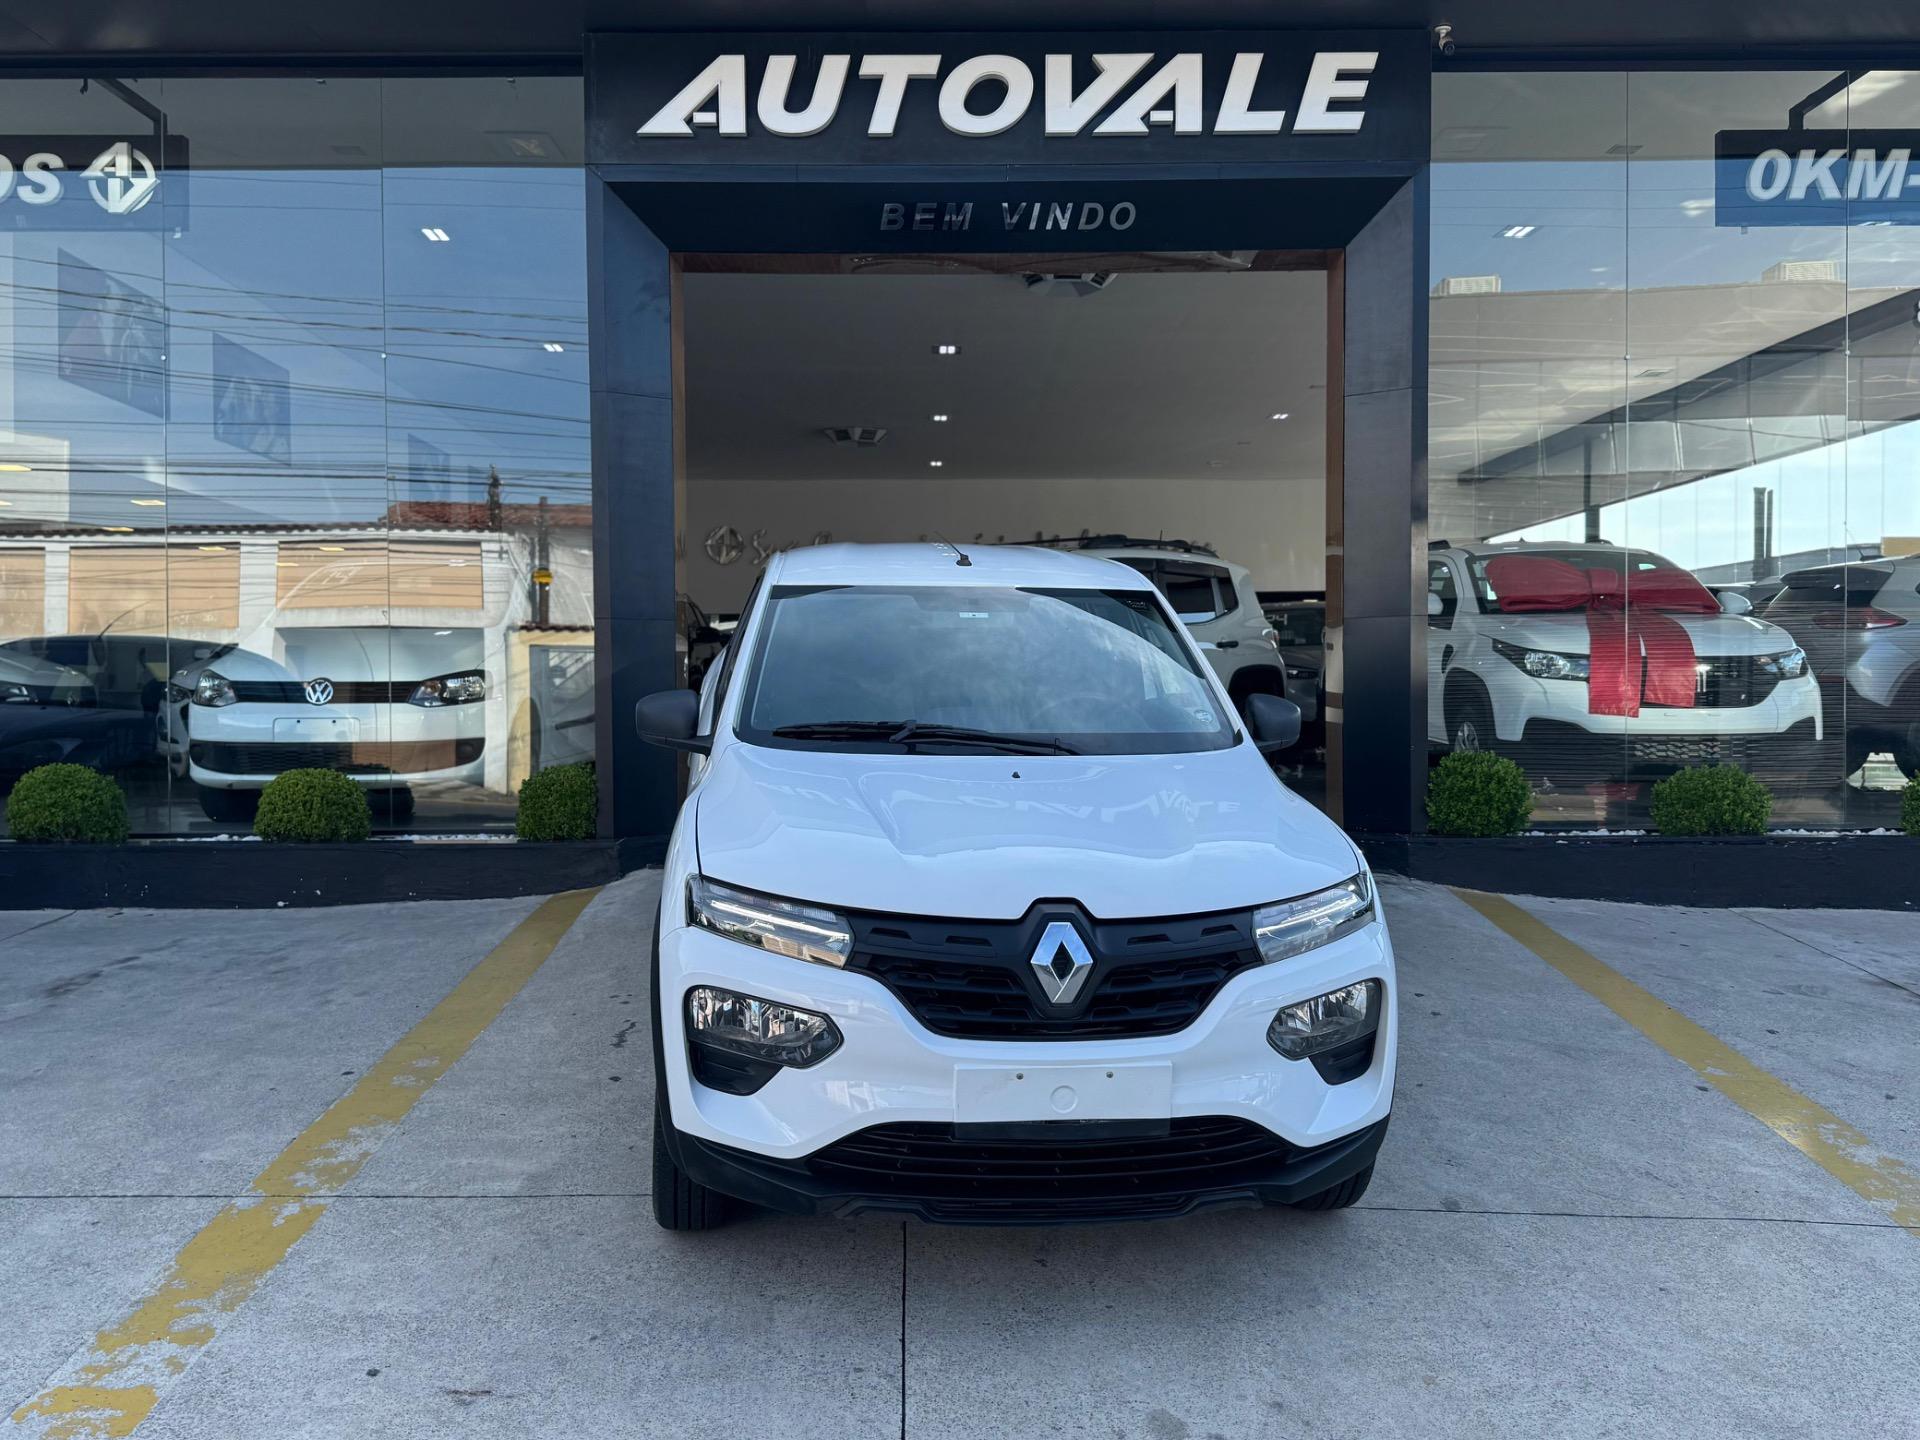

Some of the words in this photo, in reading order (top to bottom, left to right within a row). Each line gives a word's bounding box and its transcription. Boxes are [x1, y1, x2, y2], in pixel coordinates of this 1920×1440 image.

[636, 51, 1380, 137] AUTOVALE
[880, 202, 974, 231] BEM
[1001, 202, 1137, 231] VINDO
